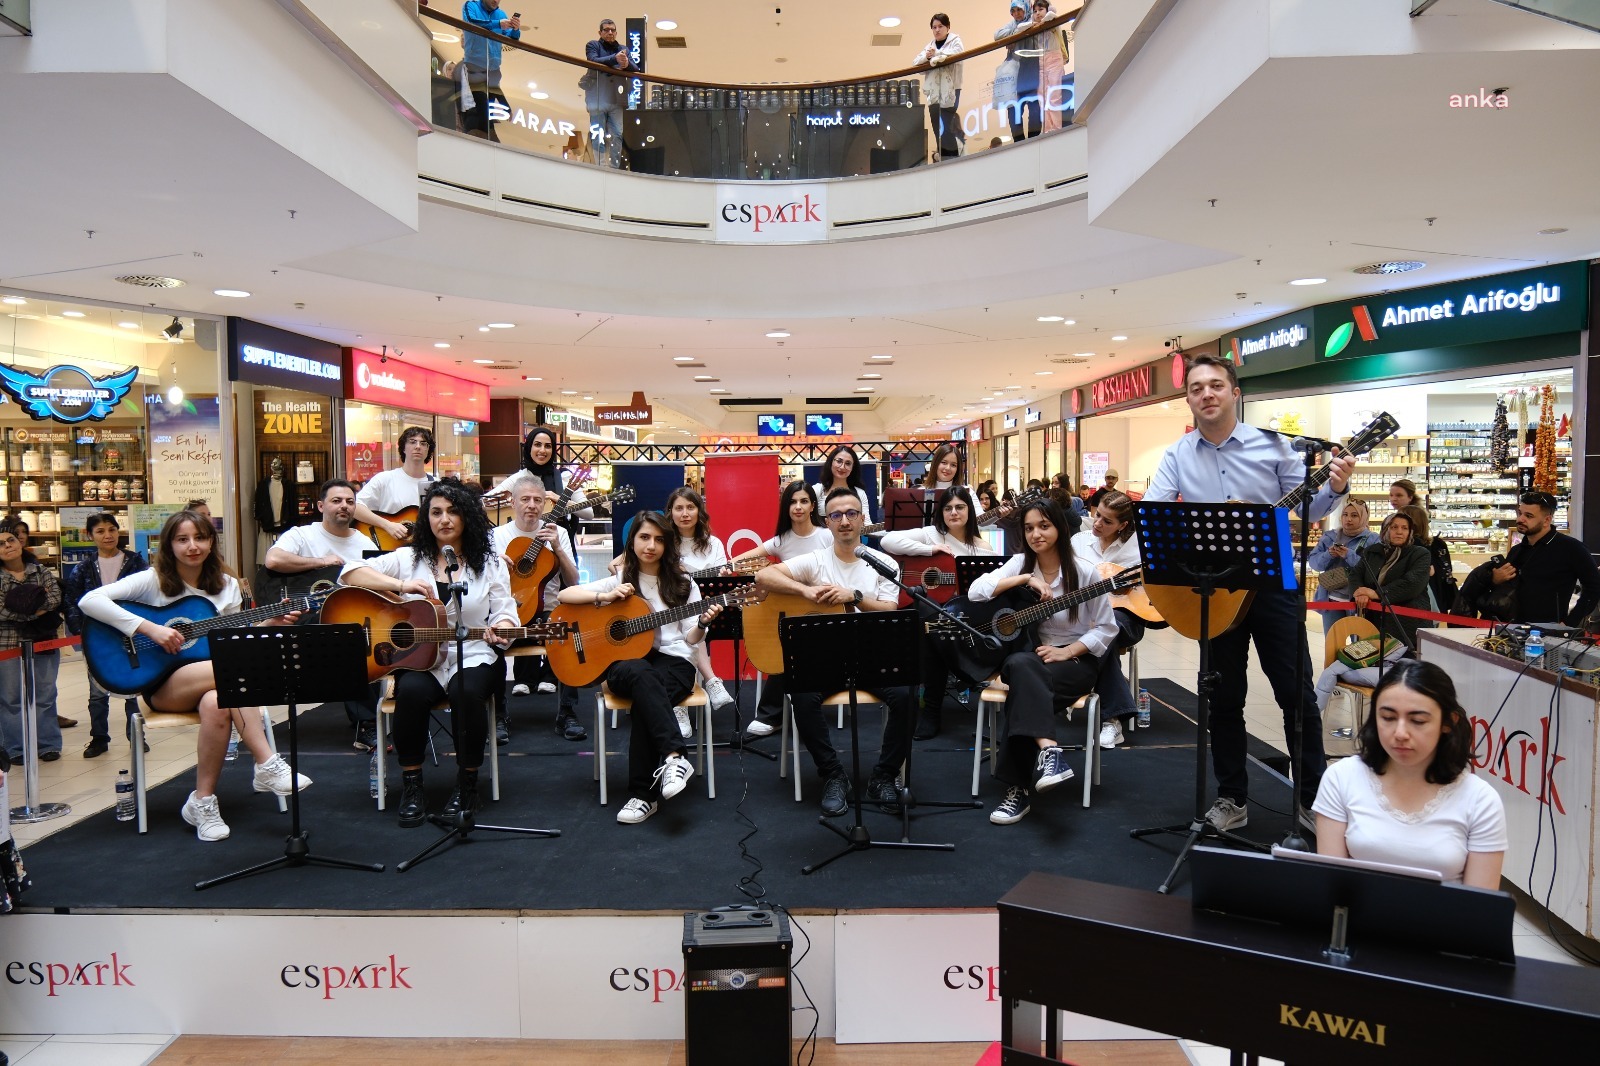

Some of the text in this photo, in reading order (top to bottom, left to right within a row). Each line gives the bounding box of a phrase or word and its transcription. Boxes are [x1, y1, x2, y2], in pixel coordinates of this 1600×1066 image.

[806, 110, 843, 128] harput
[721, 194, 822, 232] espark
[1382, 282, 1561, 327] Ahmet Arifoğlu
[1241, 324, 1308, 356] Ahmet Arifoğlu
[370, 371, 406, 392] vodafone
[1092, 366, 1151, 409] ROSSMANN
[261, 401, 321, 412] The Health
[263, 413, 322, 434] ZONE
[161, 450, 185, 462] Seni
[175, 434, 191, 446] En
[5, 952, 136, 997] espark
[280, 954, 413, 999] espark
[609, 967, 685, 1003] esp
[943, 965, 999, 1002] esp
[1280, 1003, 1387, 1047] KAWAI
